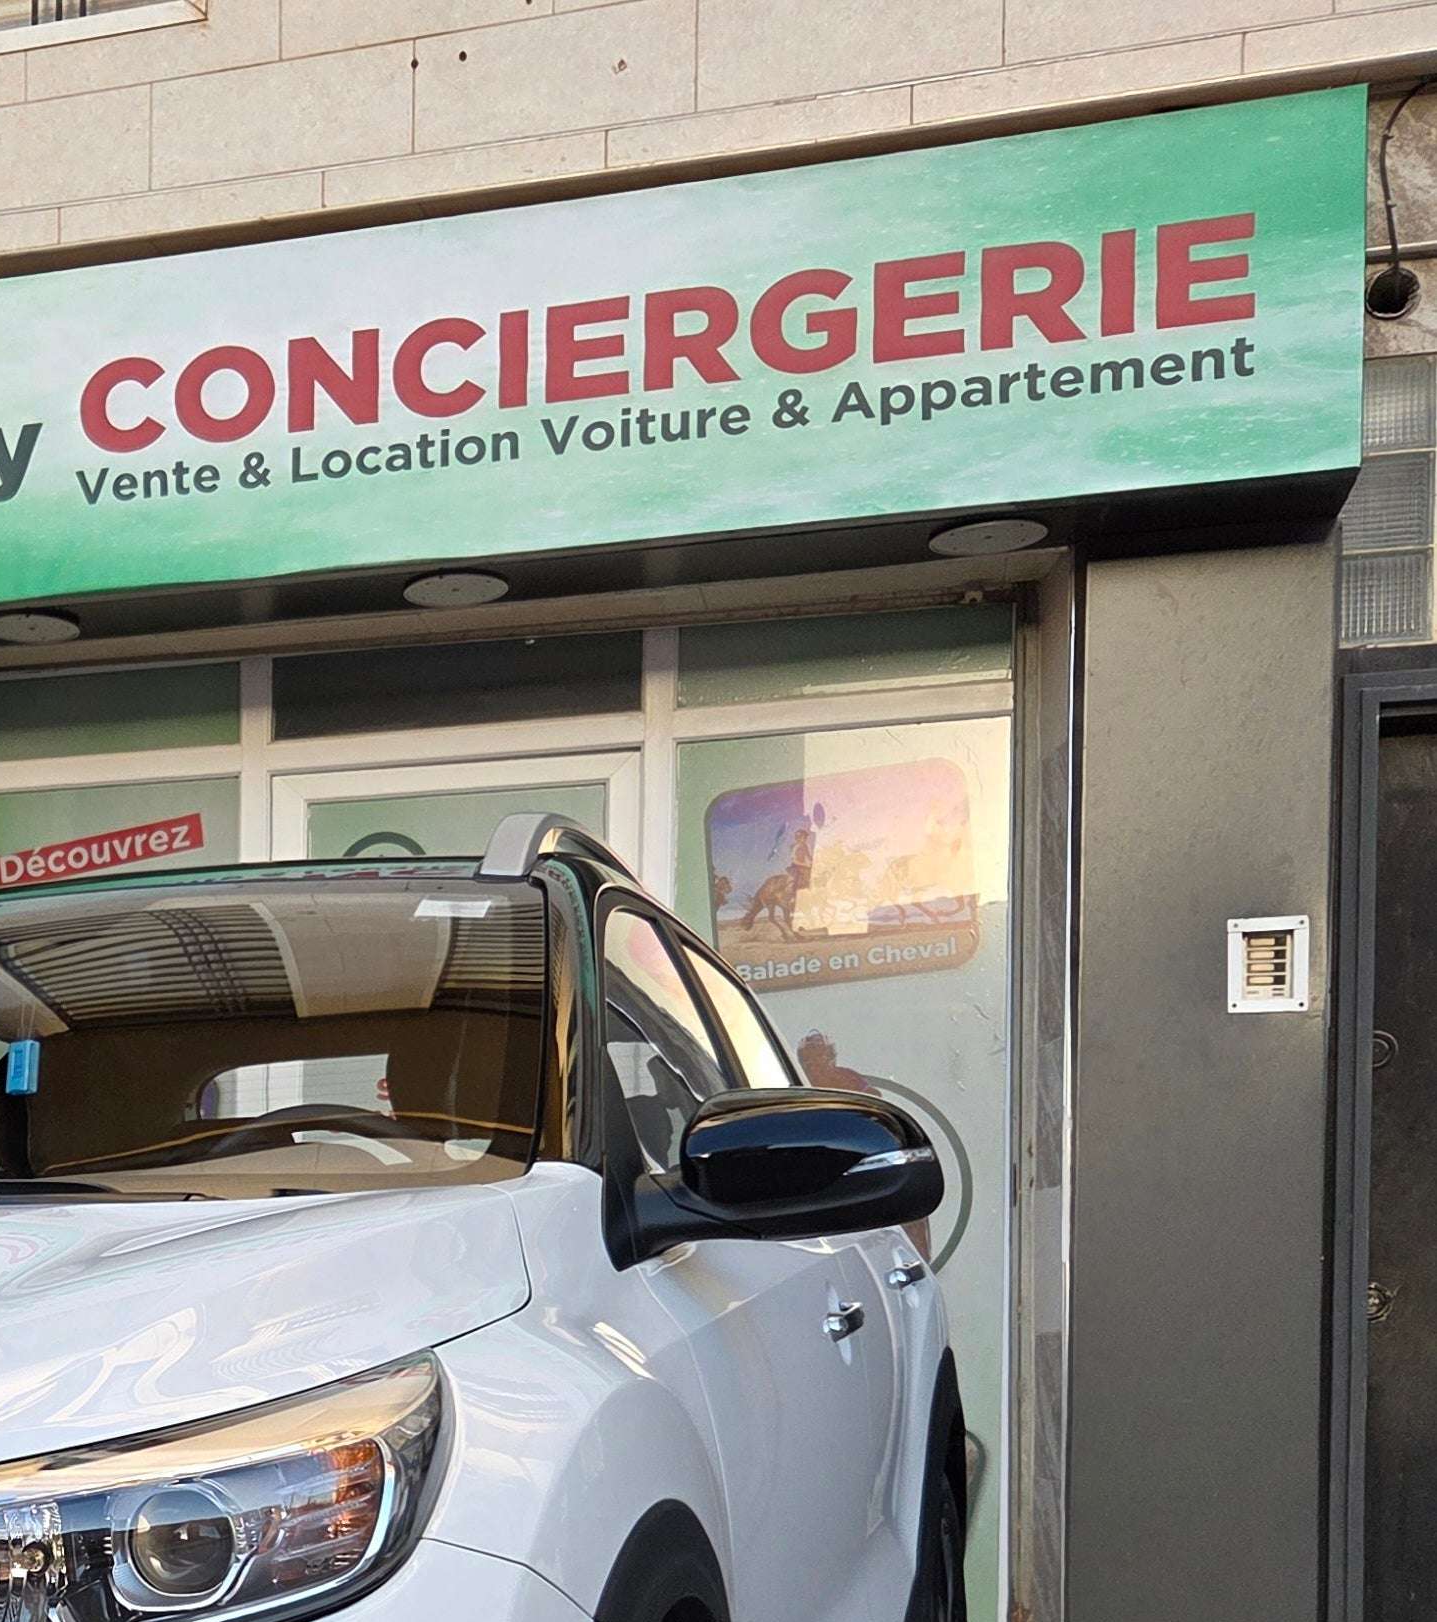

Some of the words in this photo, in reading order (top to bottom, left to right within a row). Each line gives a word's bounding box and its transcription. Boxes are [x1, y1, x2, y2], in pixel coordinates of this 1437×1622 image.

[79, 212, 1256, 453] CONCIERGERIE
[75, 460, 221, 505] Vente
[237, 451, 272, 491] &
[290, 428, 521, 483] Location
[541, 405, 751, 456] Voiture
[771, 388, 811, 429] &
[831, 336, 1257, 426] Appartement
[736, 954, 822, 983] Balade
[828, 952, 860, 972] en
[866, 936, 957, 966] Cheval
